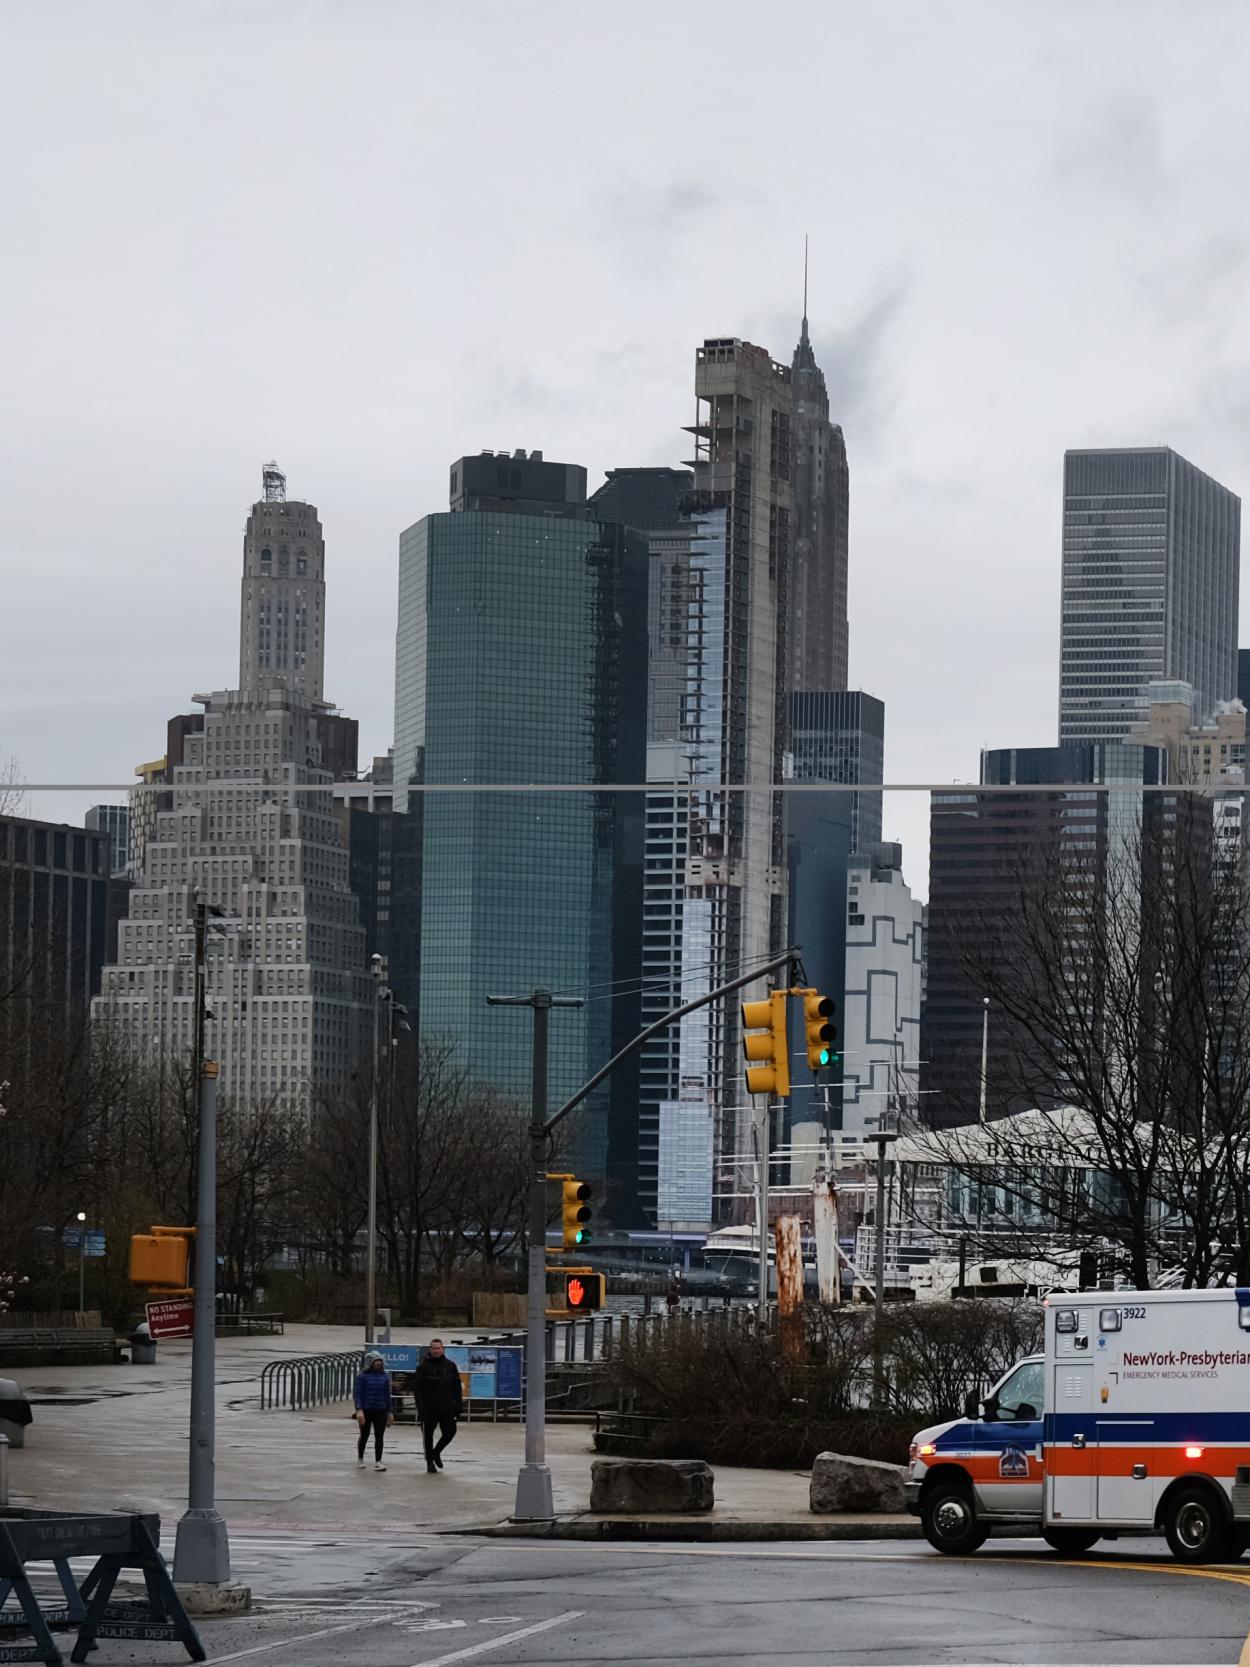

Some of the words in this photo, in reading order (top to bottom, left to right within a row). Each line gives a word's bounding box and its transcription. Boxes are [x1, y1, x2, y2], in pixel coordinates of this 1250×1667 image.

[160, 1303, 193, 1313] STANDING
[151, 1313, 179, 1322] Anytime
[1123, 1308, 1146, 1319] 3922
[383, 1353, 409, 1361] ELLO!
[1123, 1371, 1160, 1379] EMERGENCY
[1190, 1370, 1218, 1378] SERVICES
[97, 1626, 138, 1638] POLICE
[145, 1628, 174, 1640] DEPT
